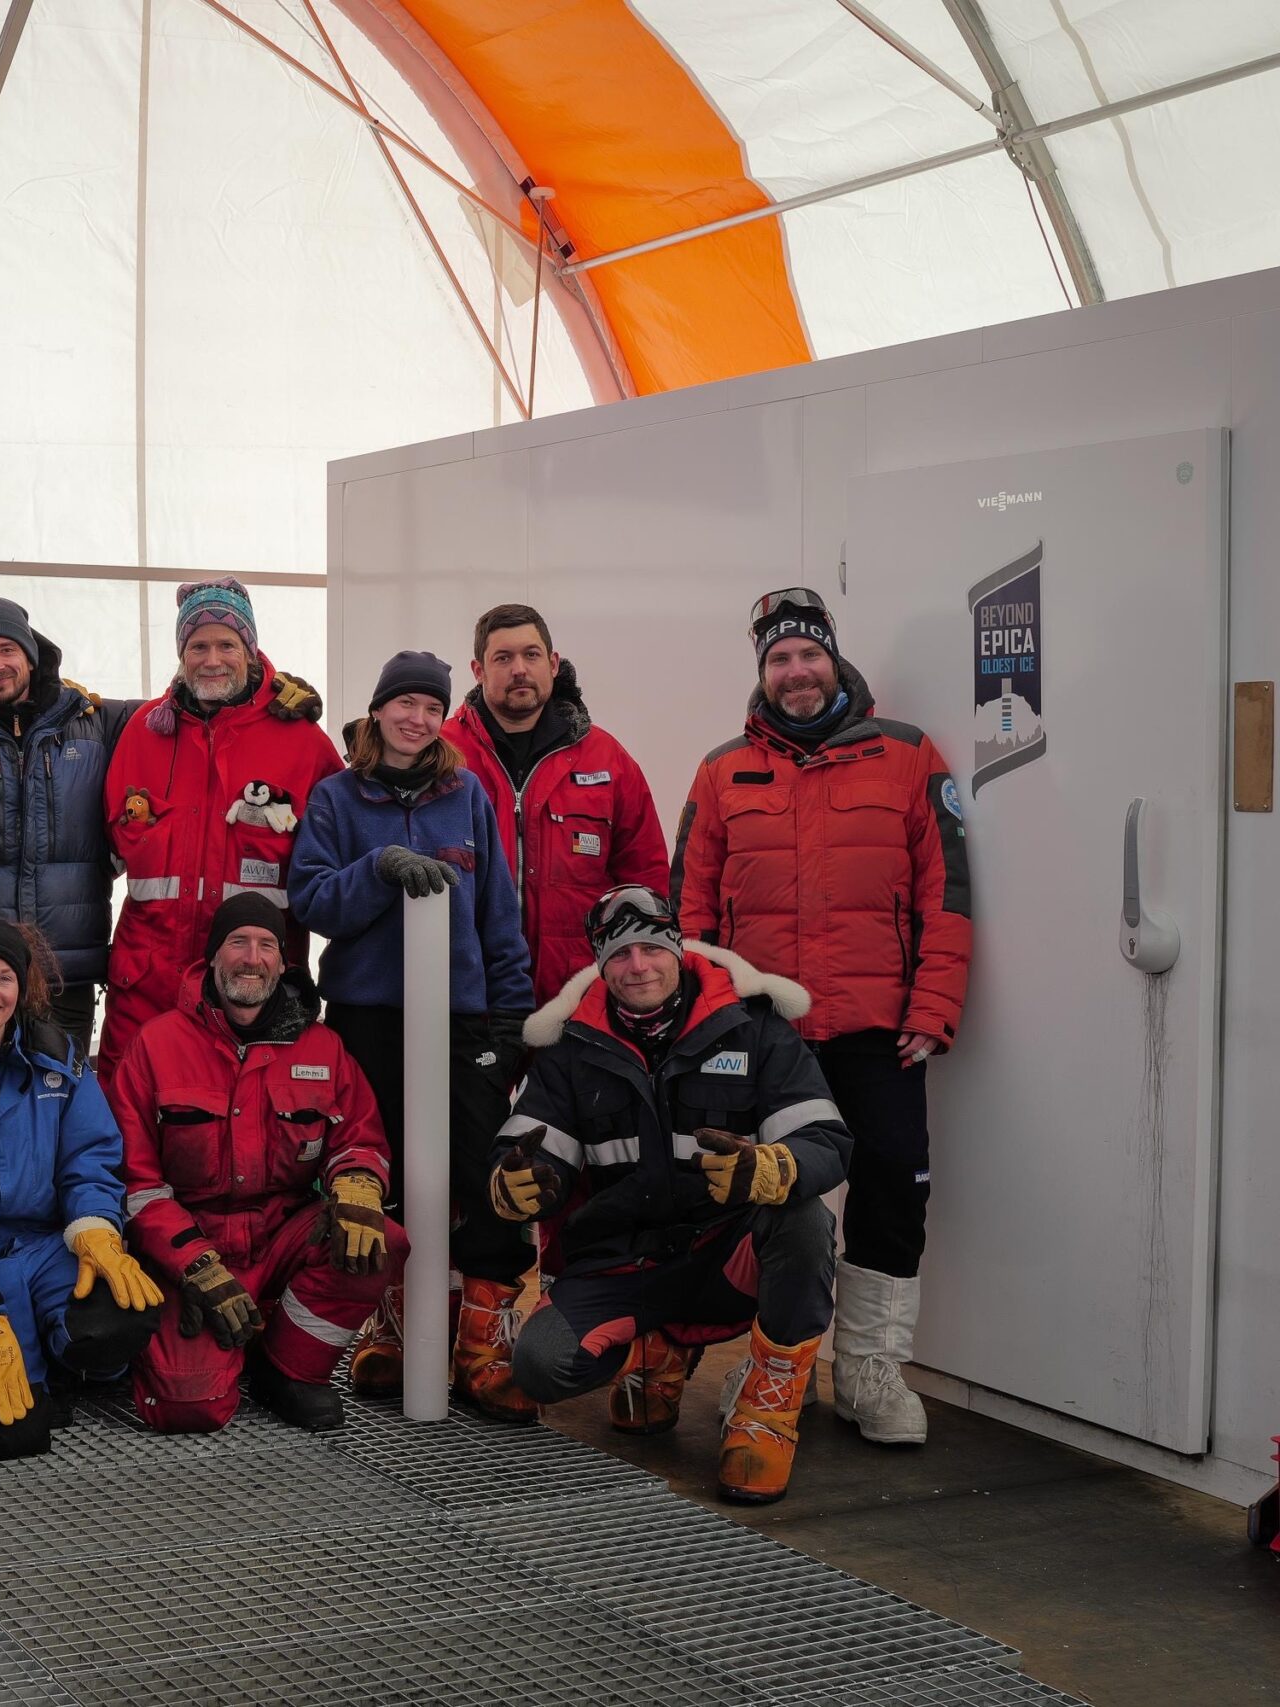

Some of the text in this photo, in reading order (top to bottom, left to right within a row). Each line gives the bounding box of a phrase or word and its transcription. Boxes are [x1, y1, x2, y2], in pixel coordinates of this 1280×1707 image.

[977, 491, 1042, 511] VIESSMANN
[981, 602, 1034, 628] BEYOND
[766, 620, 833, 650] EPICA
[981, 628, 1035, 656] EPICA
[981, 656, 1035, 674] OLDEST ICE
[295, 1066, 324, 1078] Lemmi
[715, 1057, 742, 1071] AWI
